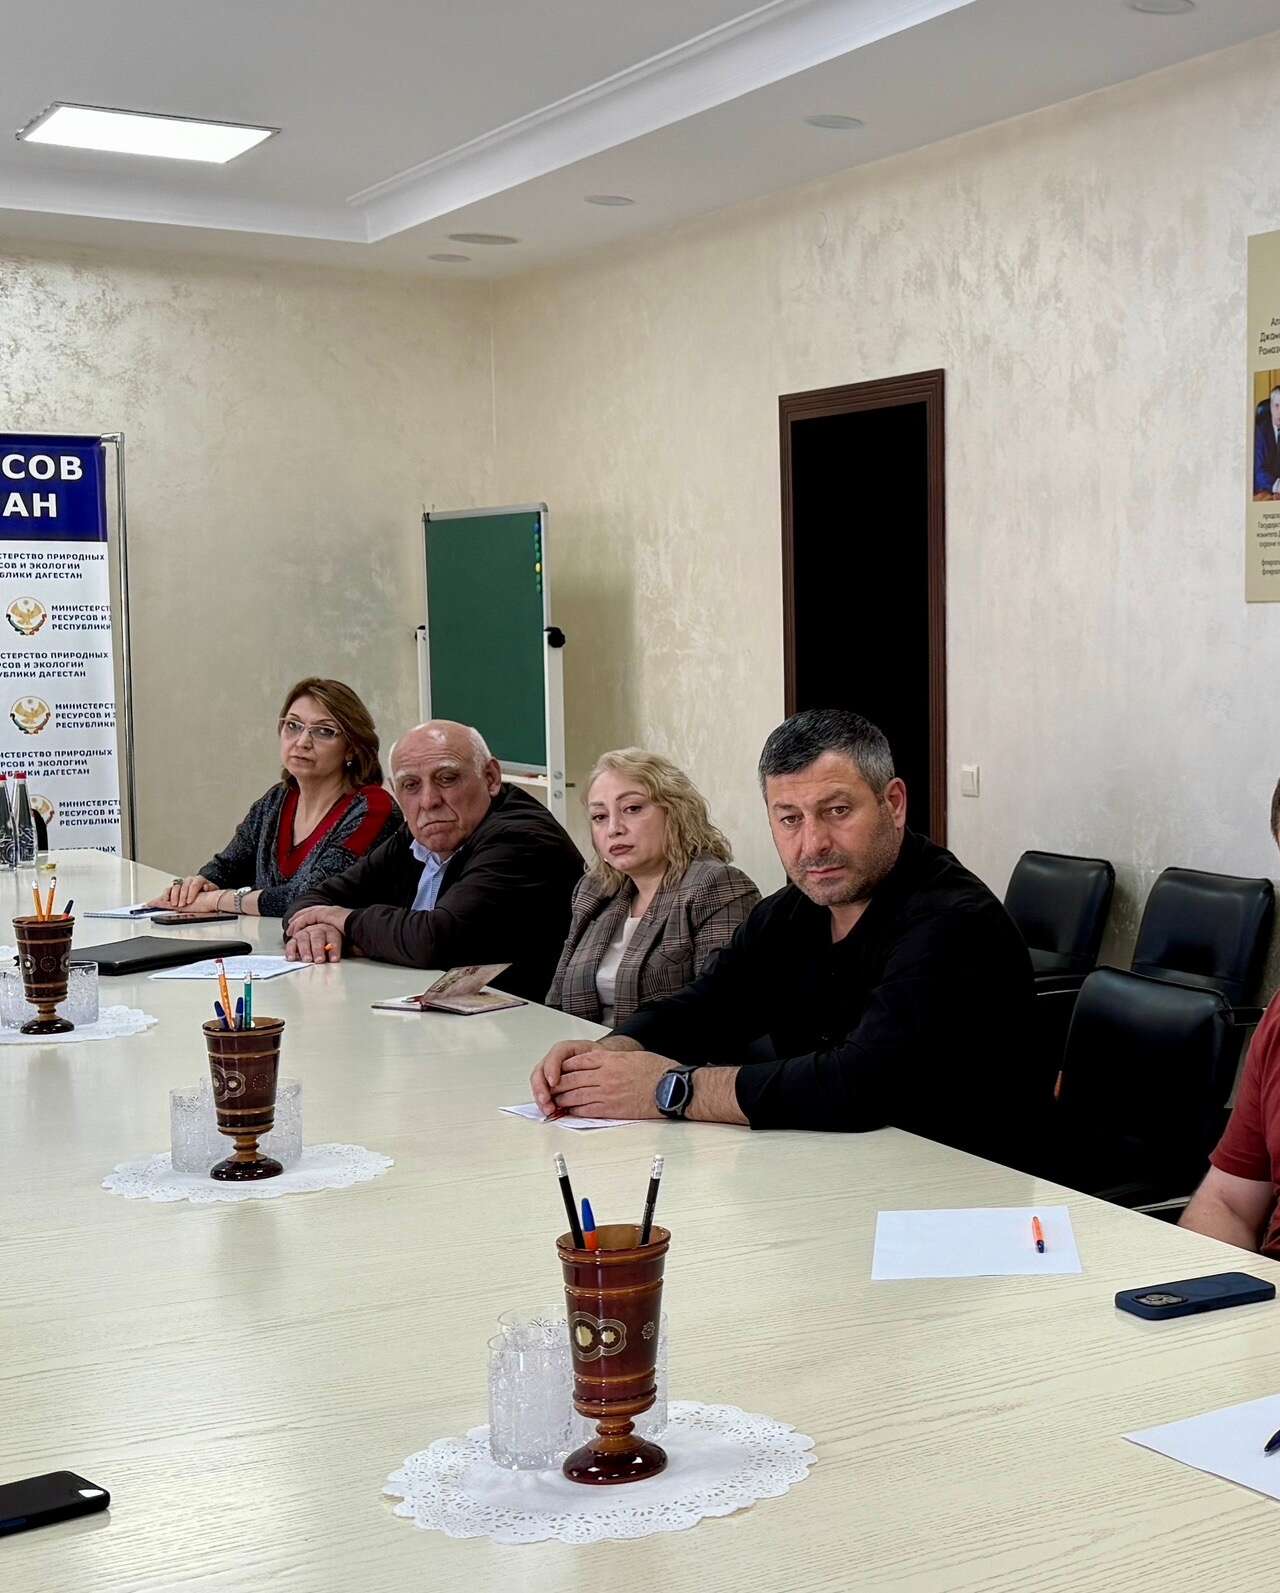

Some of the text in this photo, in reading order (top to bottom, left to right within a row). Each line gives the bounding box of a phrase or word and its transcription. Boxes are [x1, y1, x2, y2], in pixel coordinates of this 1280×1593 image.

[1, 453, 83, 481] СОВ
[2, 492, 57, 518] АН
[47, 553, 105, 561] ПРИРОДНЫХ
[29, 562, 81, 570] ЭКОЛОГИИ
[35, 571, 83, 579] ДАГЕСТАН
[50, 652, 108, 660] ПРИРОДНЫХ
[0, 661, 84, 669] СОВ И ЭКОЛОГИИ
[38, 670, 86, 679] ДАГЕСТАН
[54, 749, 113, 758] ПРИРОДНЫХ
[38, 759, 88, 767] ЭКОЛОГИИ
[43, 768, 90, 777] ДАГЕСТАН
[60, 809, 105, 817] РЕСУРСОВ
[60, 818, 120, 826] РЕСПУБЛИКИ
